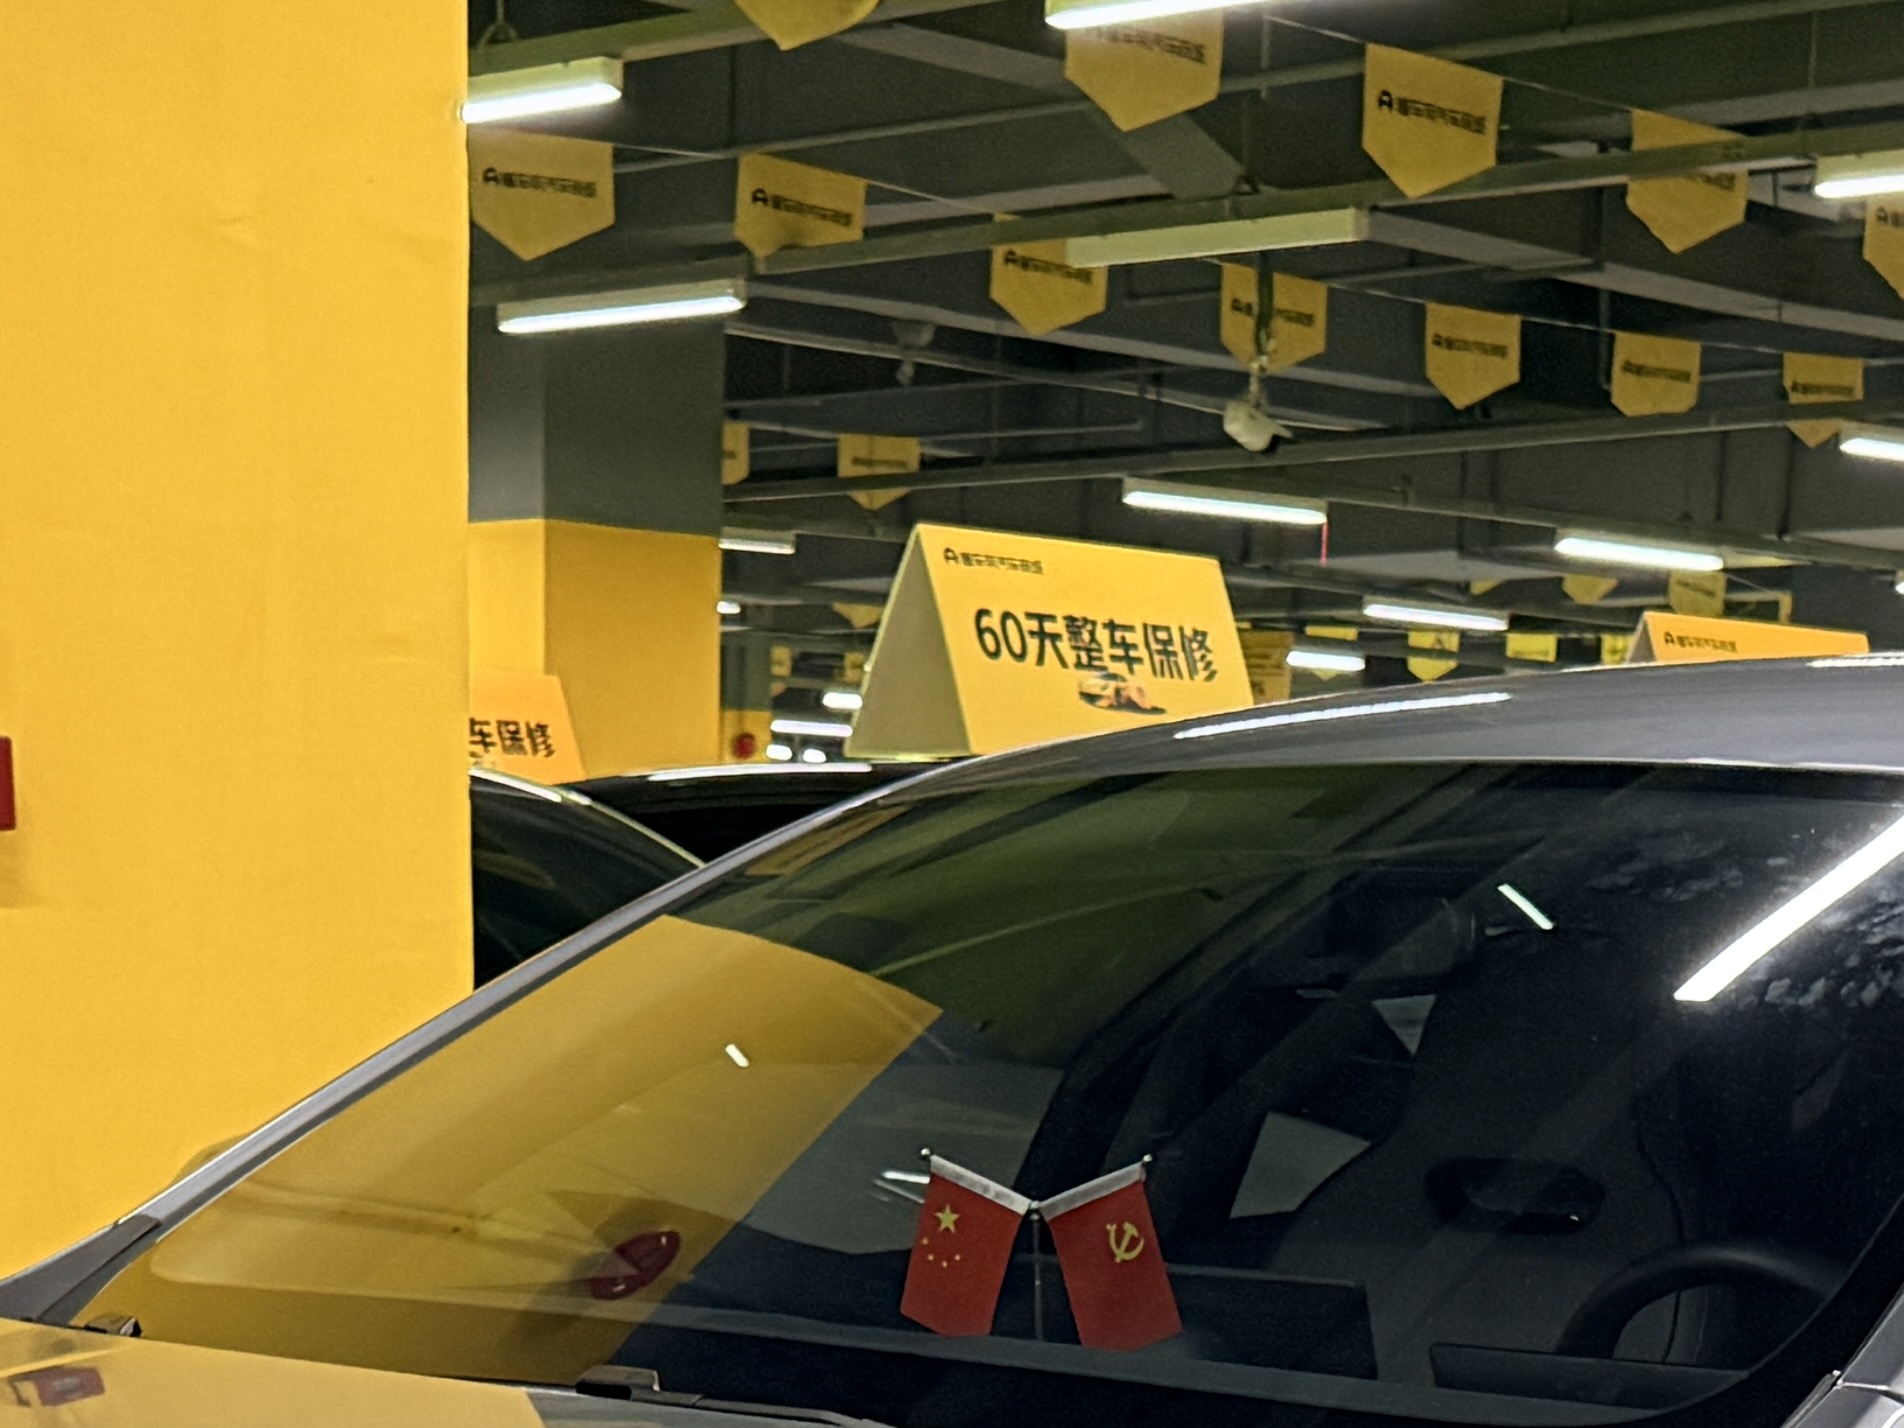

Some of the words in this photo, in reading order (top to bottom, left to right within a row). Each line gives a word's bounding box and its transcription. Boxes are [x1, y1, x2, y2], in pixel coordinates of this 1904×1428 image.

[974, 608, 1218, 682] 60天整车保修
